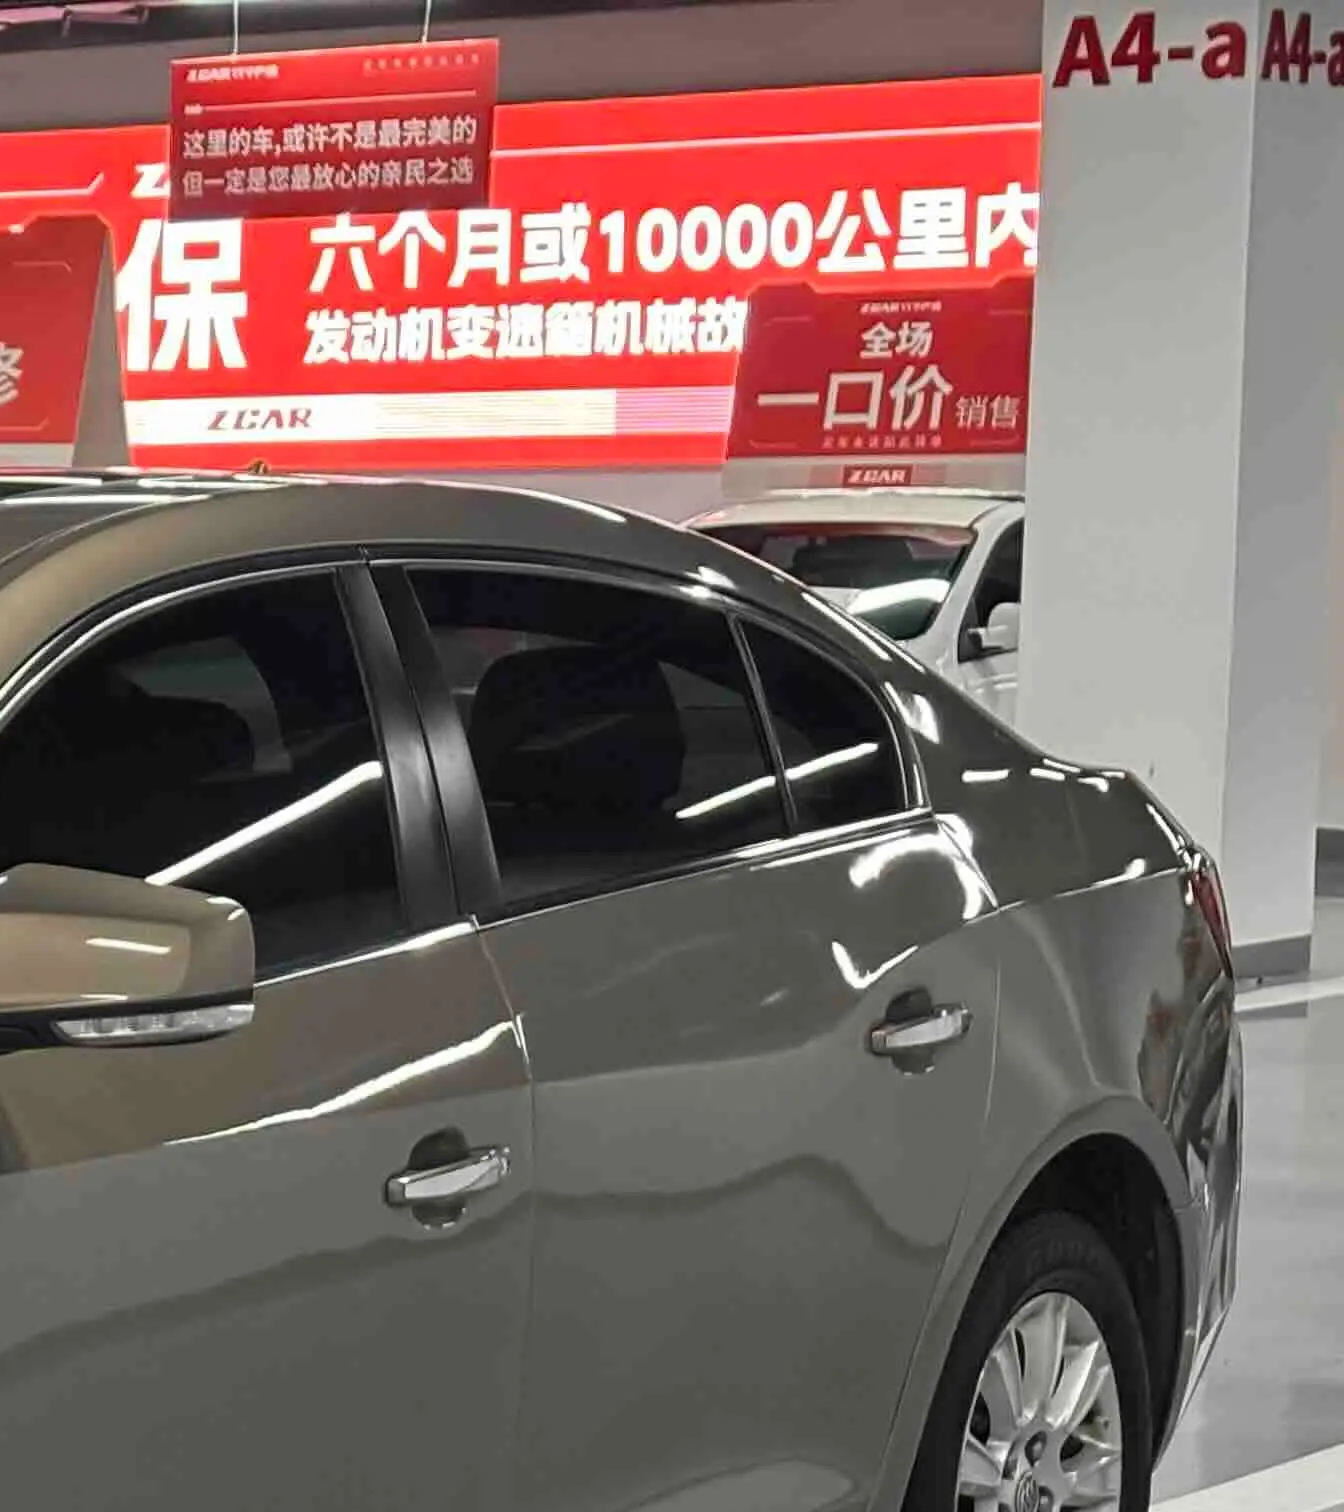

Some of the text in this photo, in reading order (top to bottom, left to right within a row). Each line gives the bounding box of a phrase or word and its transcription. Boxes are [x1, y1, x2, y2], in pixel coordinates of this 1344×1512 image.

[1052, 12, 1247, 88] A4-a
[860, 321, 934, 359] 全场
[757, 363, 1023, 431] 一口价 销售
[207, 408, 313, 432] ZCAR
[847, 468, 908, 485] ZCAR
